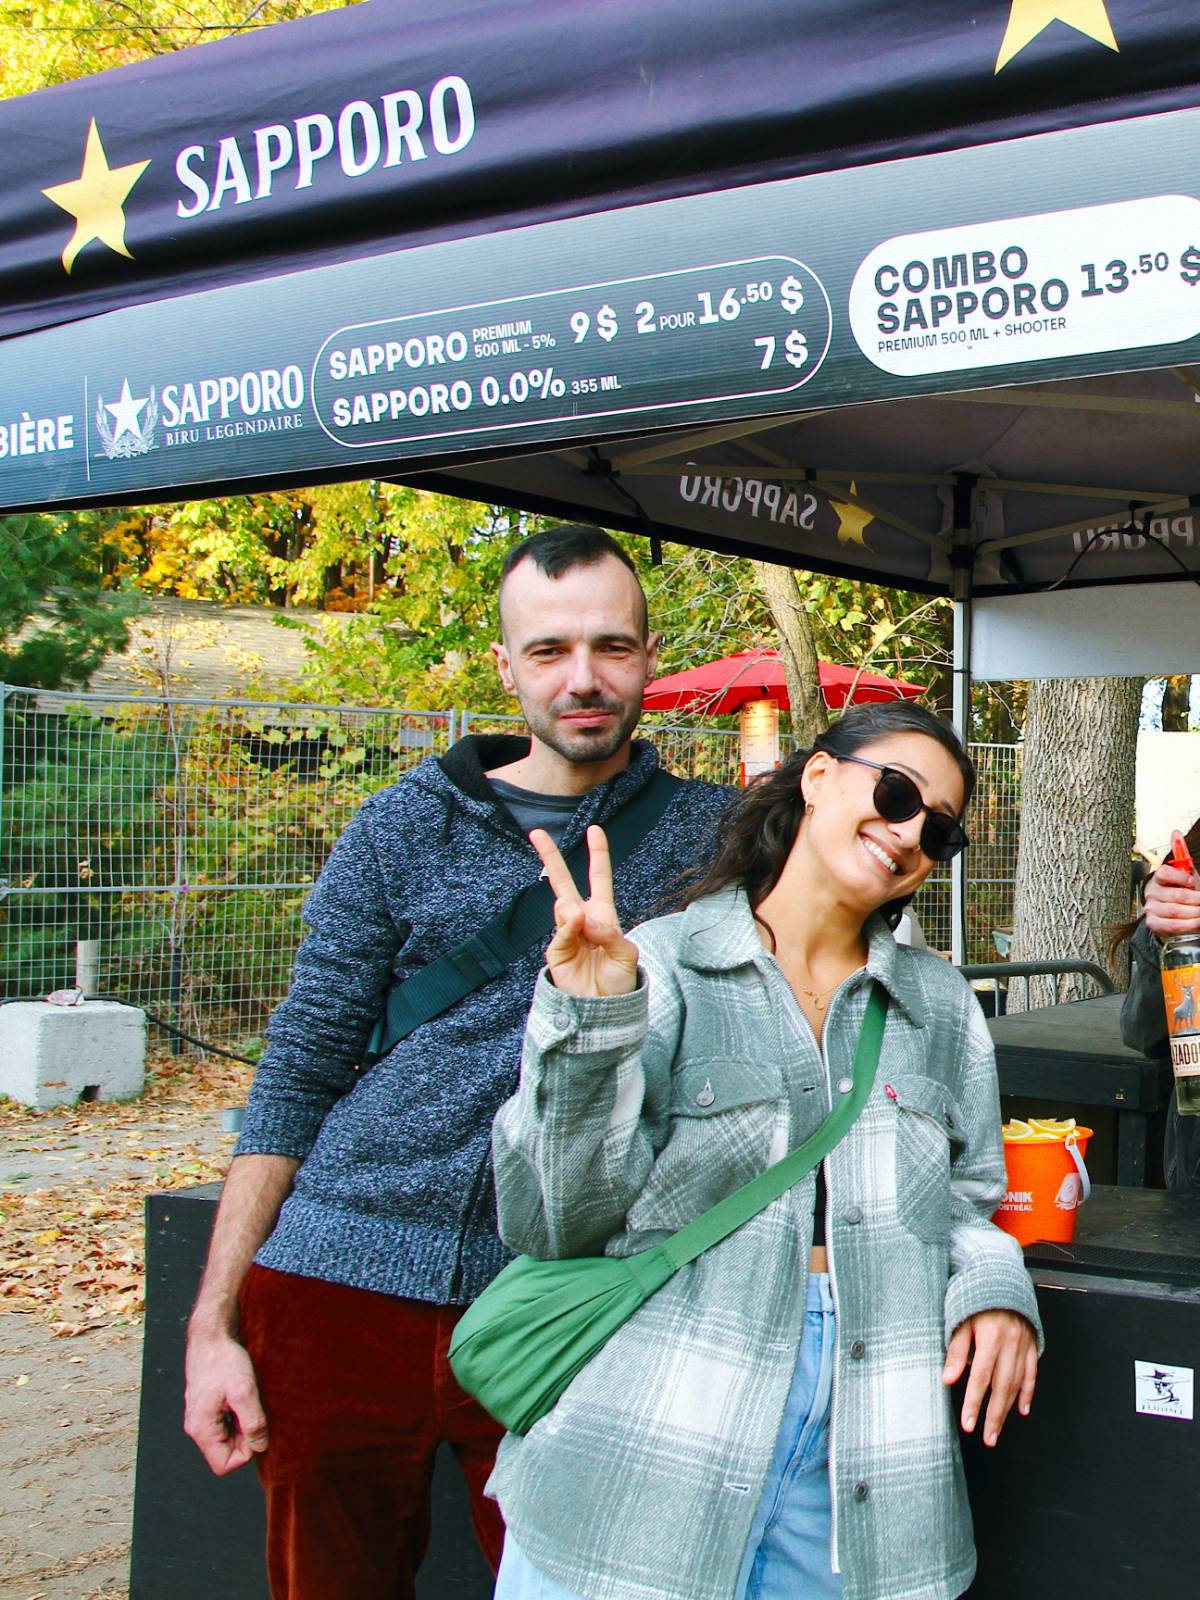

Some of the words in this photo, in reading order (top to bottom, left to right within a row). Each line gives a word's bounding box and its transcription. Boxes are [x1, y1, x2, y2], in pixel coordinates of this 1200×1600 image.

[175, 75, 476, 218] SAPPORO
[874, 245, 1028, 298] COMBO
[877, 278, 1070, 335] SAPPORO
[878, 333, 938, 353] PREMIUM
[941, 330, 967, 345] 500
[970, 326, 989, 341] ML
[1004, 317, 1067, 336] SHOOTER
[330, 331, 468, 380] SAPPORO
[472, 320, 532, 343] PREMIUM
[635, 301, 657, 334] 2
[659, 312, 696, 331] POUR
[474, 342, 499, 358] 500
[502, 339, 522, 354] ML
[532, 333, 556, 351] 5%
[162, 365, 304, 427] SAPPORO
[333, 380, 473, 428] SAPPORO
[481, 368, 566, 407] 0.0%
[571, 378, 598, 395] 355
[601, 375, 622, 392] ML
[754, 336, 775, 370] 7
